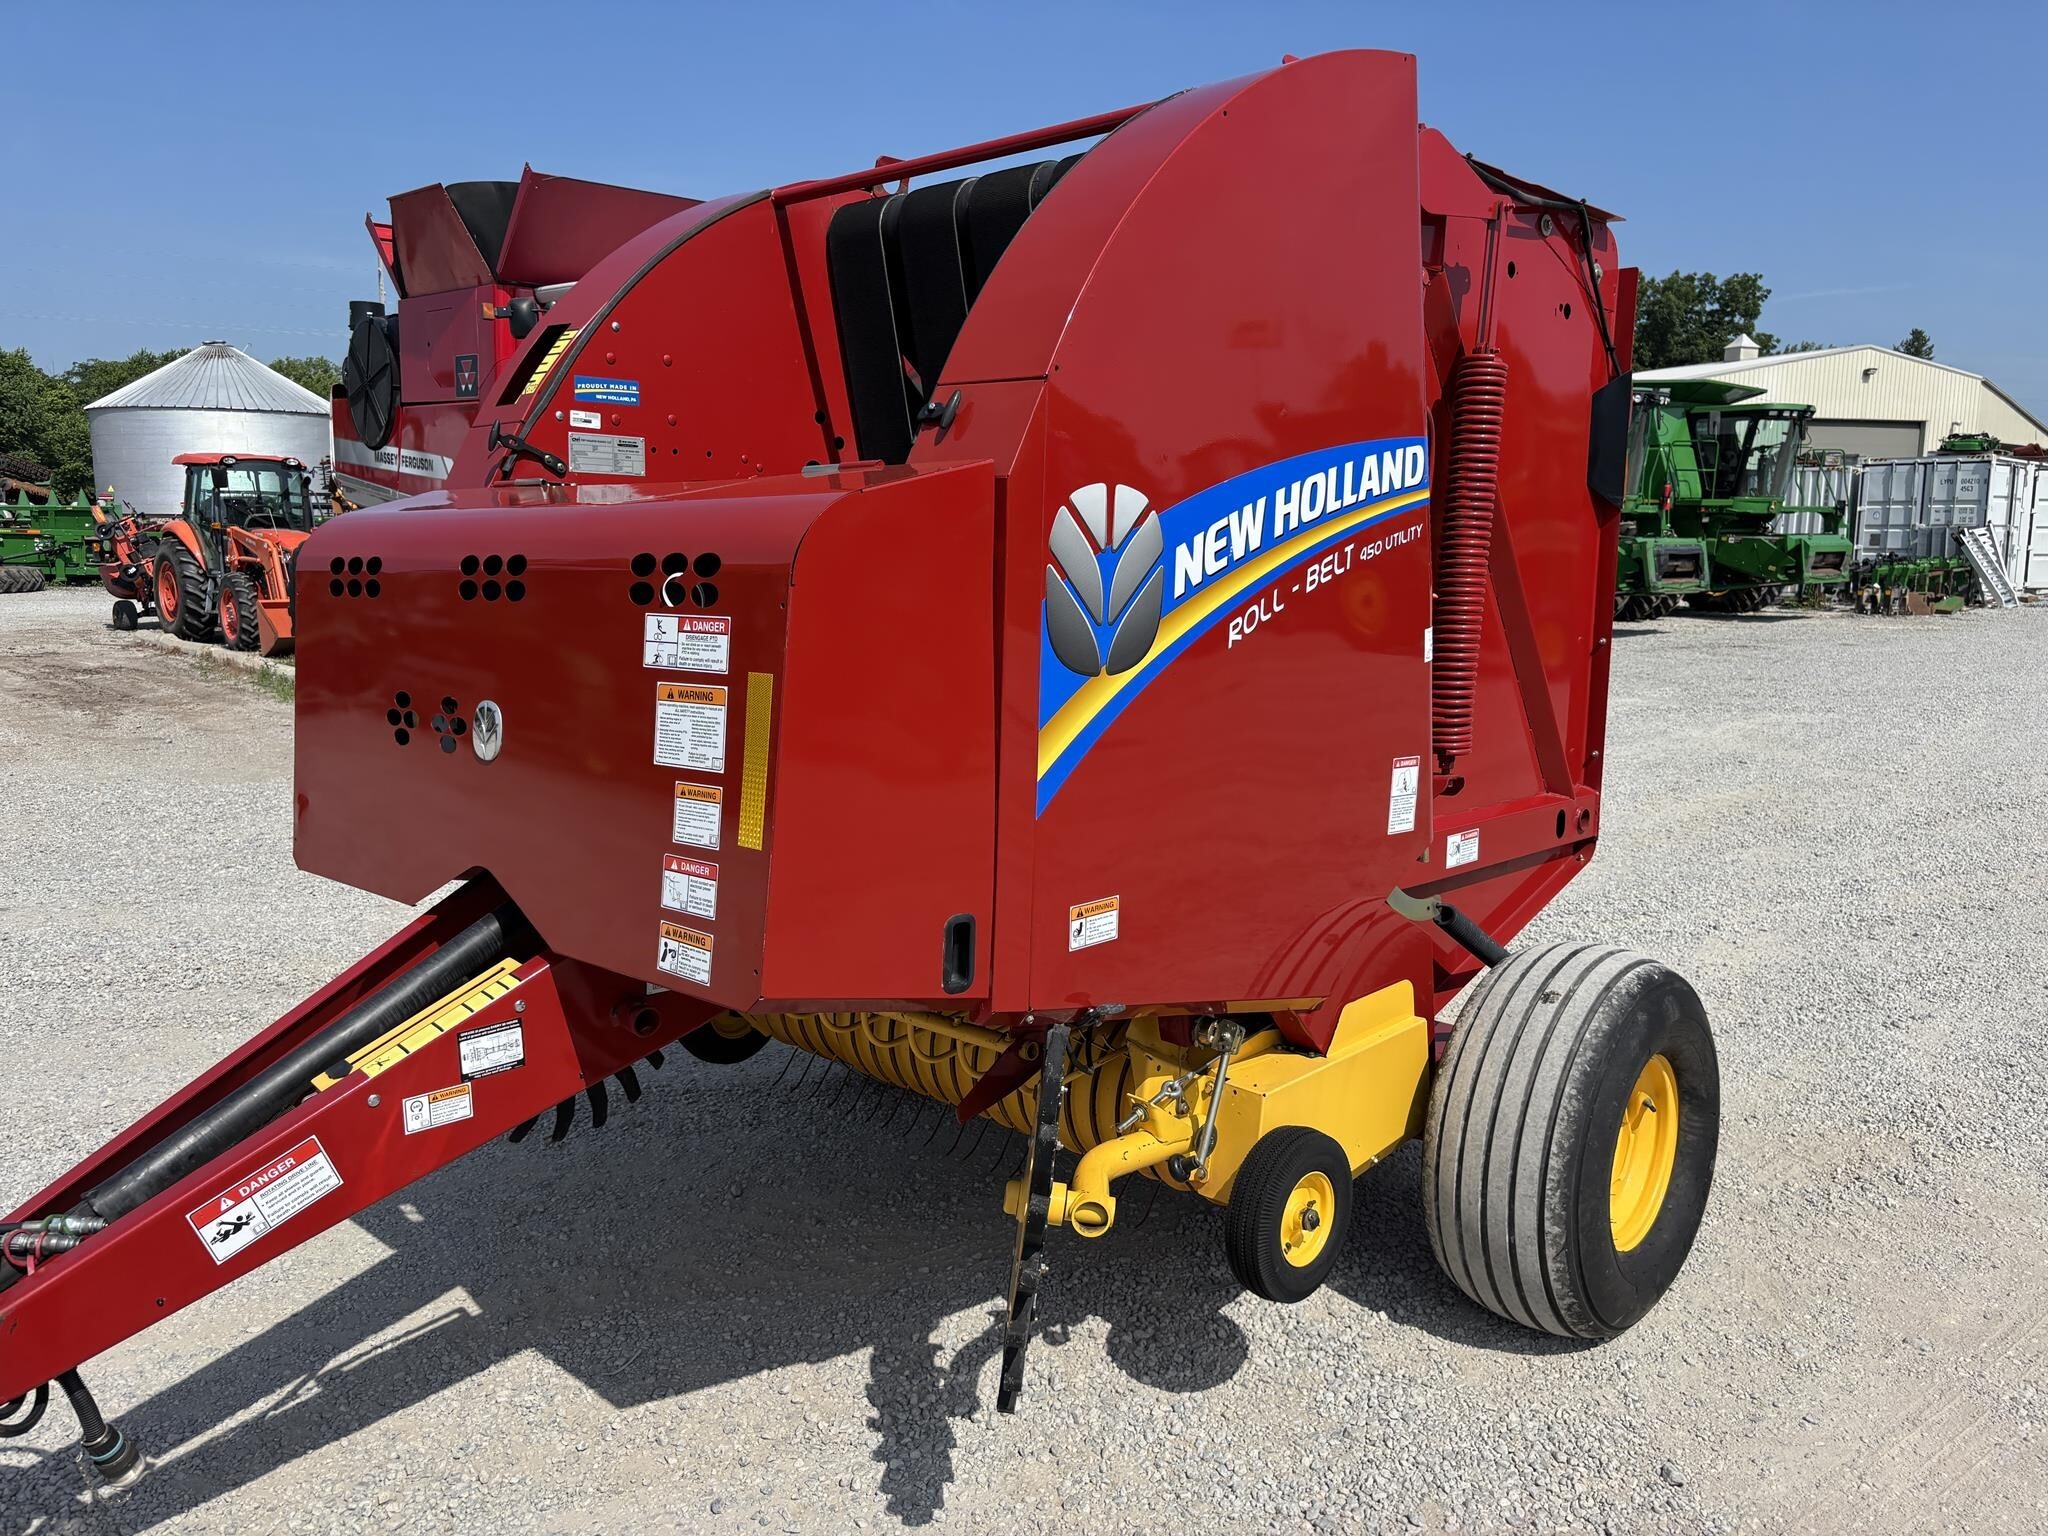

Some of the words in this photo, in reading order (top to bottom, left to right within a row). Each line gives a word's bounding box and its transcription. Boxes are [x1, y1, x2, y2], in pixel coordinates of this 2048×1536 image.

[375, 450, 397, 464] MASSEY
[401, 455, 434, 471] FERGUSON
[1174, 496, 1266, 599] NEW
[1274, 444, 1425, 539] HOLLAND
[1227, 587, 1285, 649] ROLL
[1305, 543, 1355, 593] BELT
[1359, 541, 1383, 562] 450
[1385, 524, 1423, 551] UTILITY
[693, 621, 725, 632] DANGER
[678, 690, 714, 701] WARNING
[687, 789, 717, 800] WARNING
[681, 862, 710, 876] DANGER
[1085, 901, 1114, 914] WARNING
[672, 928, 706, 947] WARNING
[440, 1087, 466, 1098] WARNING
[239, 1157, 296, 1197] DANGER
[260, 1179, 288, 1199] ROTATING
[287, 1168, 305, 1181] DRIVE
[304, 1159, 318, 1170] LINE
[265, 1195, 278, 1206] Keep
[283, 1181, 300, 1193] shields
[300, 1175, 310, 1183] and
[309, 1165, 325, 1178] guards
[267, 1205, 285, 1219] Failure
[291, 1190, 310, 1204] comply
[309, 1183, 319, 1192] will
[318, 1174, 332, 1186] result
[288, 1189, 297, 1197] and
[276, 1208, 291, 1220] death
[297, 1192, 316, 1206] serious
